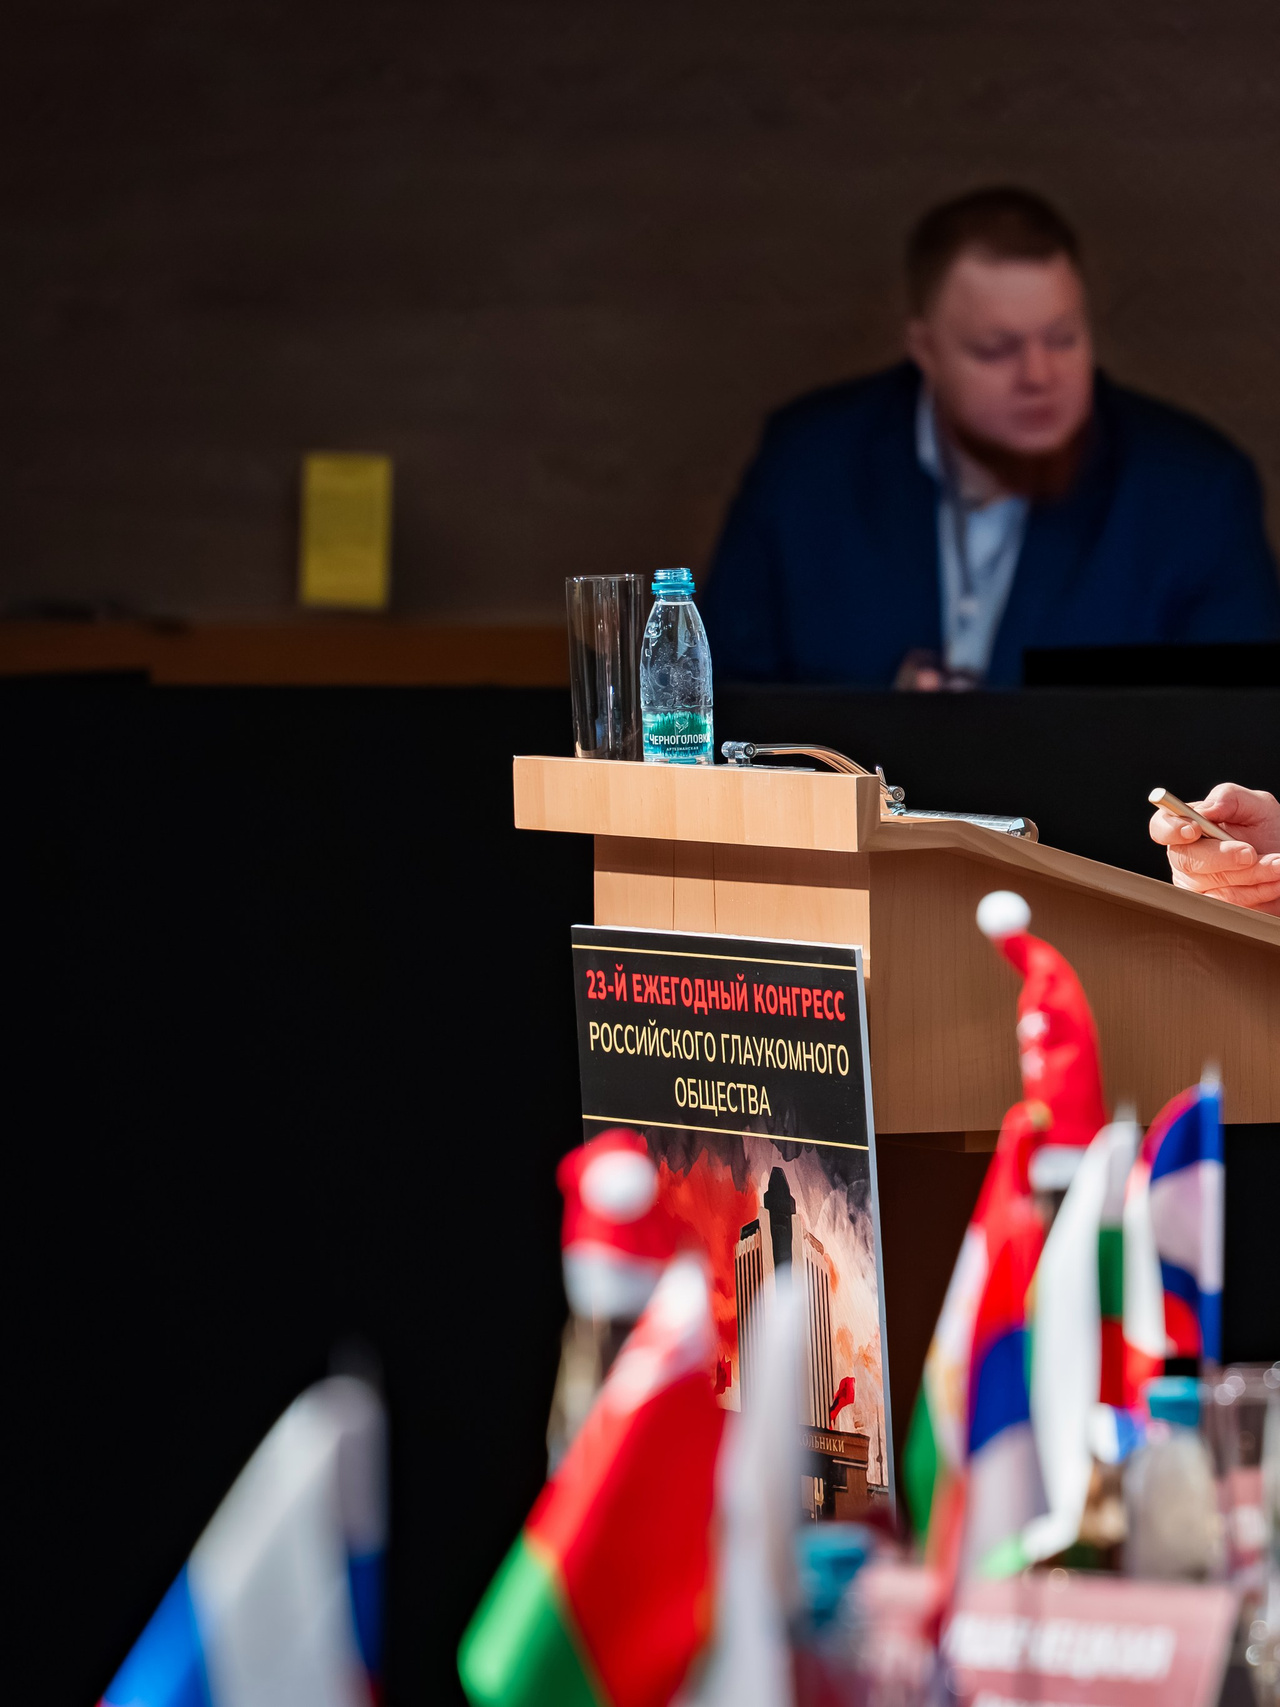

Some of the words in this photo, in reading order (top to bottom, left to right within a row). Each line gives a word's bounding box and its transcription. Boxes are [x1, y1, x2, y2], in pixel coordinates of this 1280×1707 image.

[585, 964, 627, 1002] 23-Й
[632, 973, 749, 1016] ЕЖЕГОДНЫЙ
[753, 983, 846, 1022] КОНГРЕСС
[589, 1019, 717, 1063] РОССИЙСКОГО
[720, 1033, 850, 1077] ГЛАУКОМНОГО
[674, 1077, 772, 1117] ОБЩЕСТВА
[800, 1433, 845, 1453] ОЛЬНИКИ
